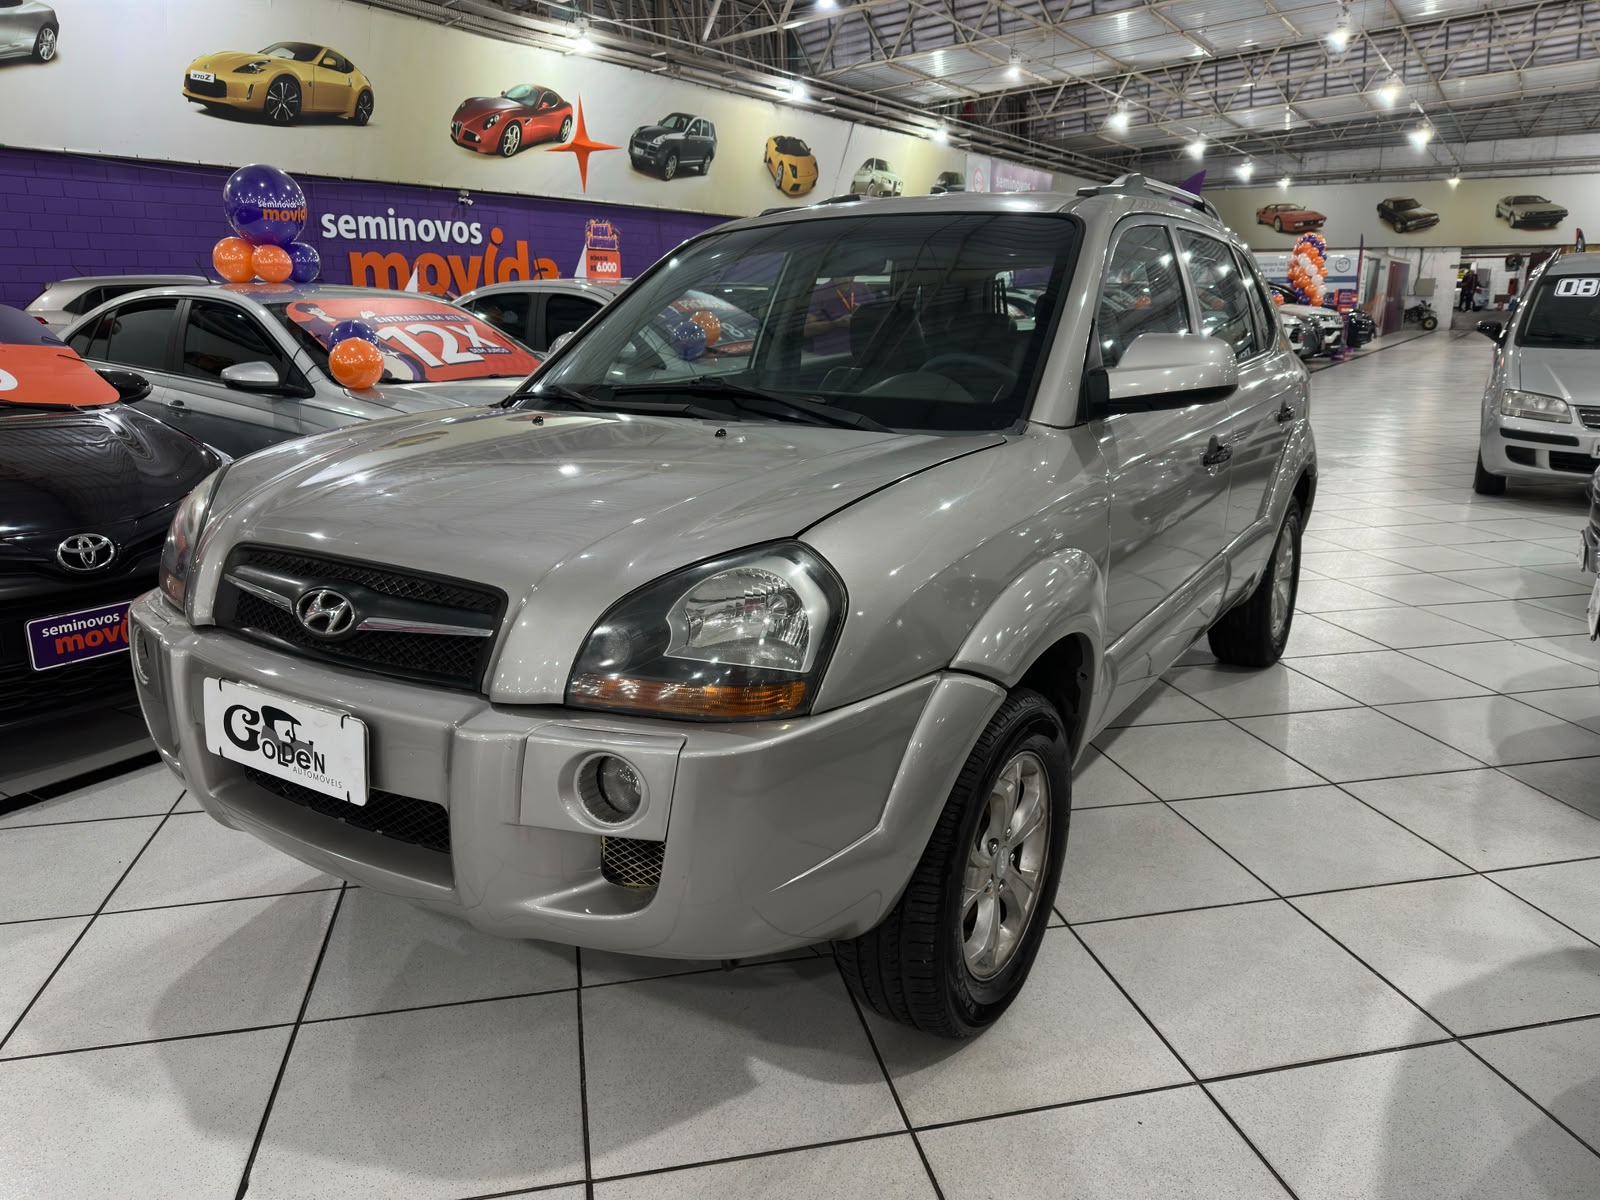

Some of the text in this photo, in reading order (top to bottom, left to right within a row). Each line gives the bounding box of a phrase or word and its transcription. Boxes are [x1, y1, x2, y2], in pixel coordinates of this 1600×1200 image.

[263, 208, 307, 223] movid
[321, 207, 483, 245] seminovos
[349, 227, 559, 296] movida
[597, 261, 617, 273] 6.000
[1557, 278, 1600, 296] 08
[374, 314, 427, 323] ENTRADA
[42, 613, 120, 638] seminovos
[55, 611, 130, 655] movi
